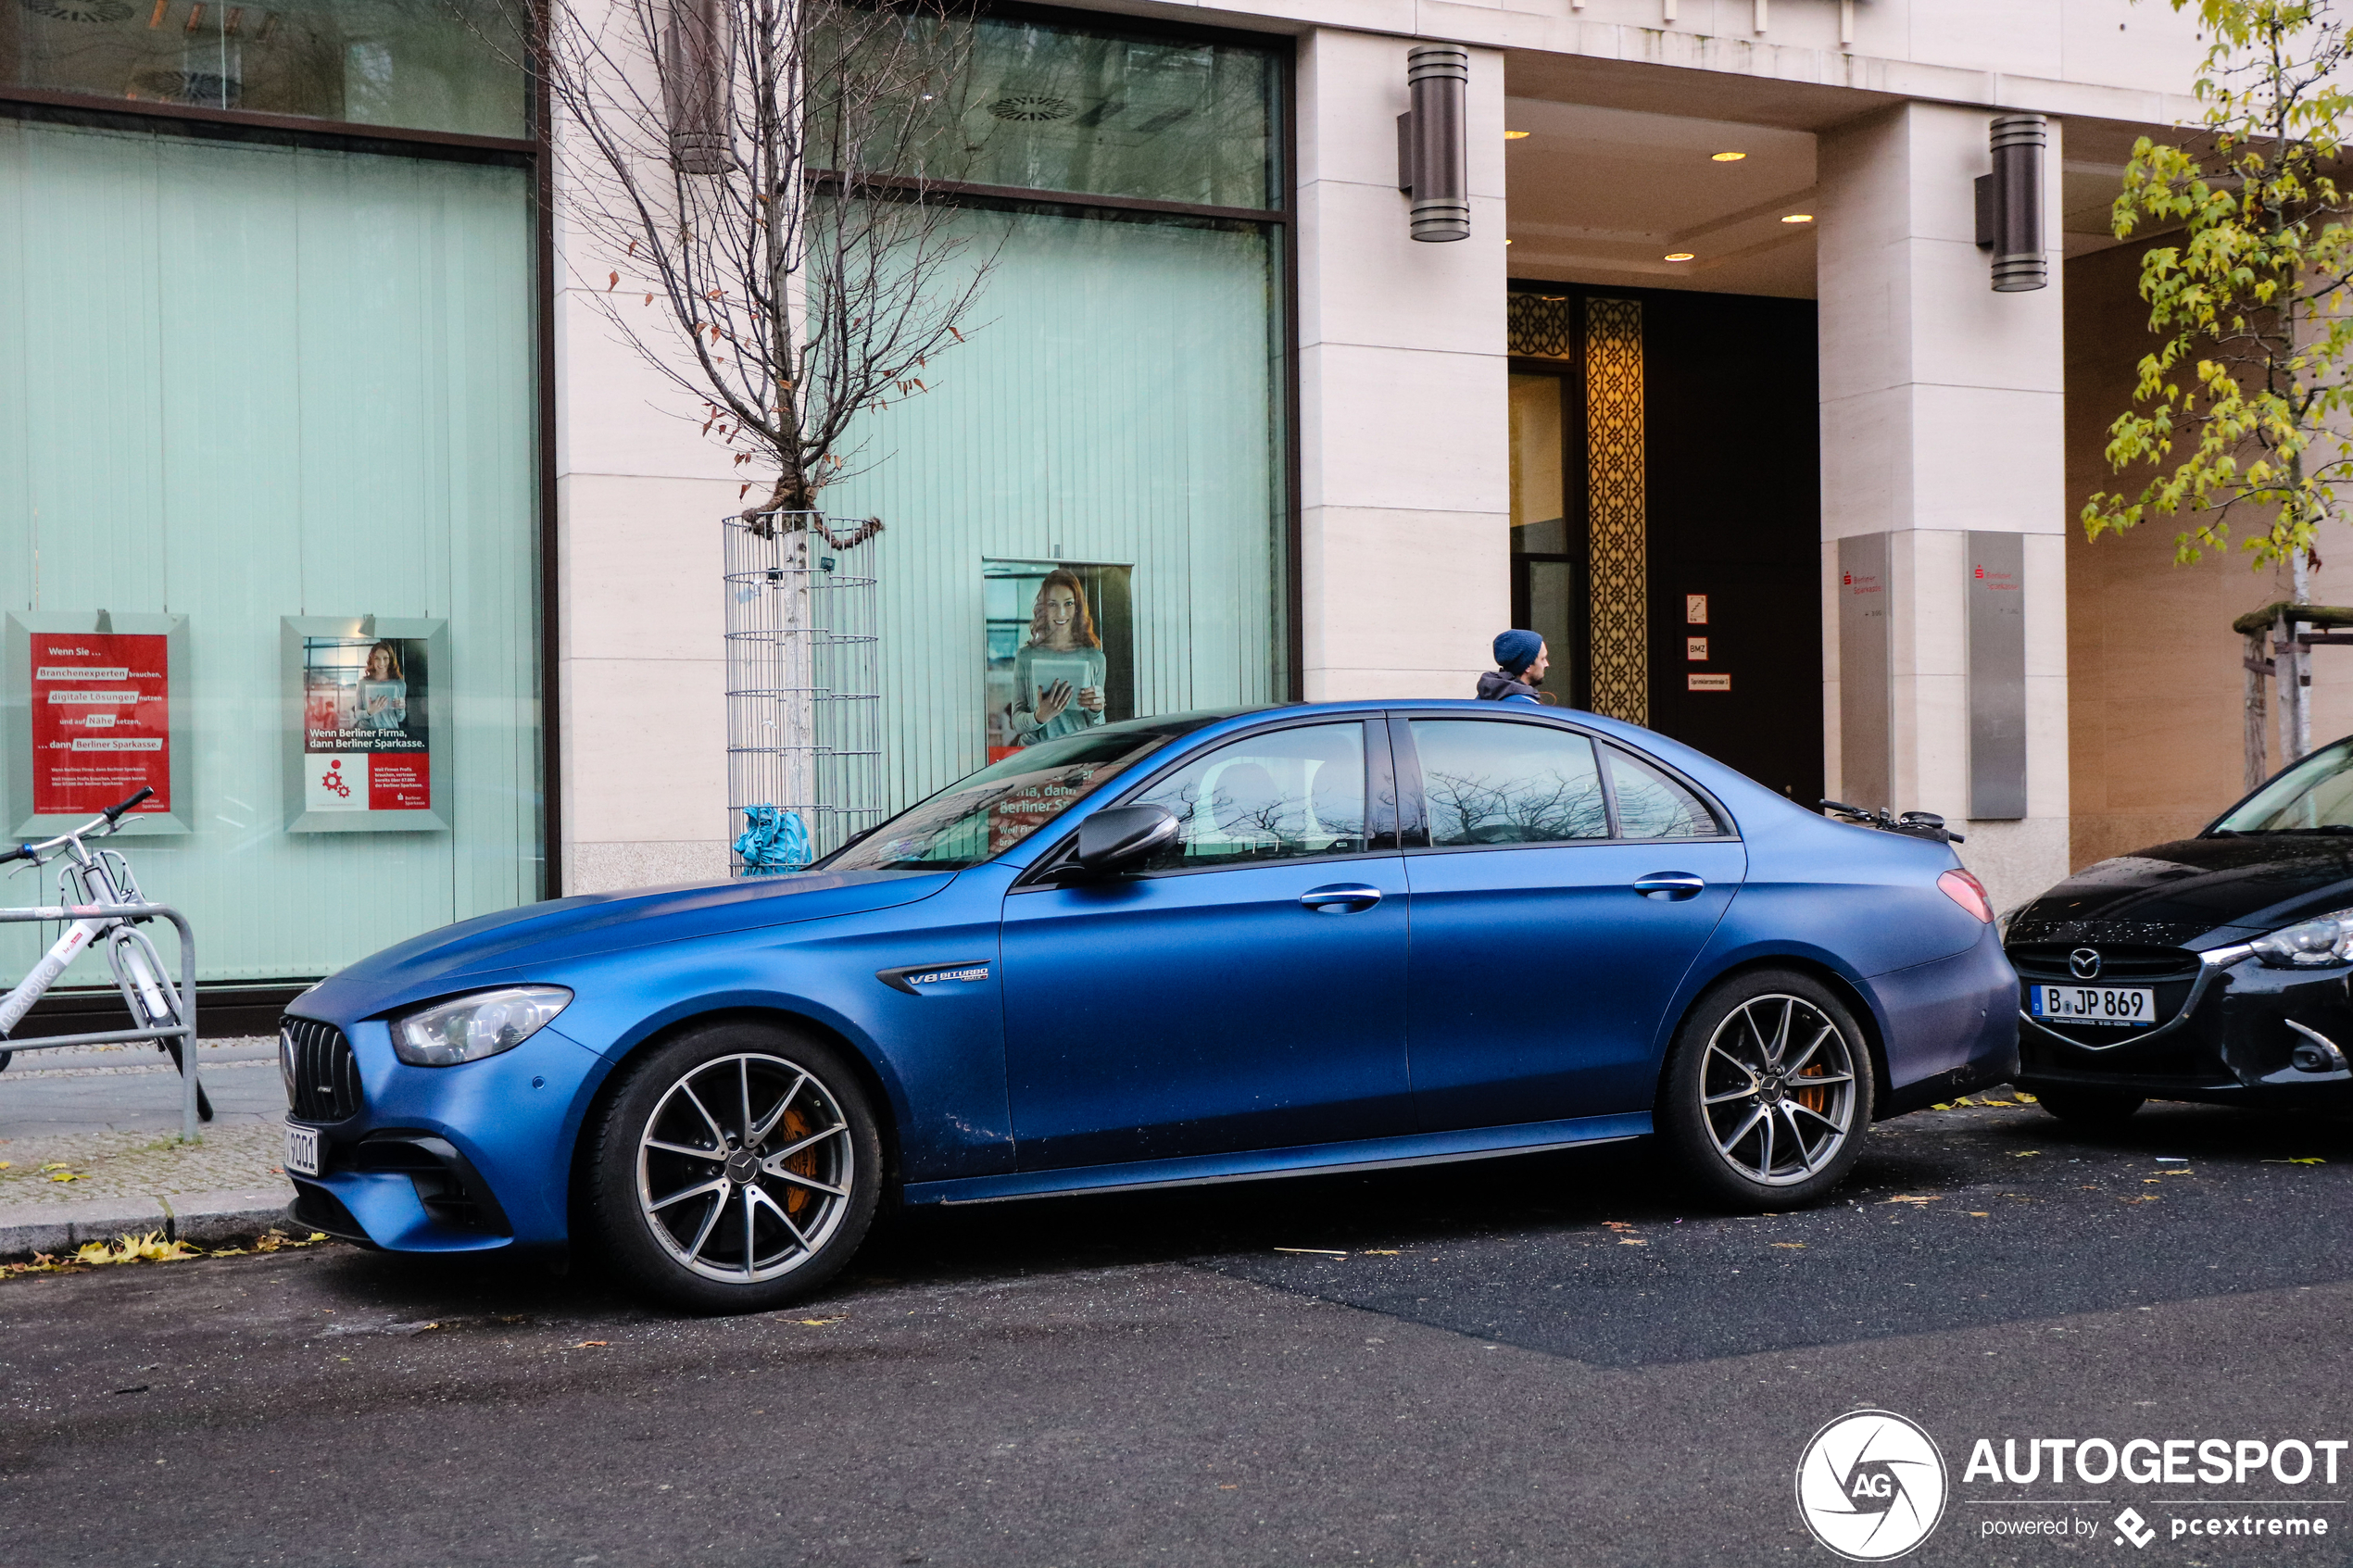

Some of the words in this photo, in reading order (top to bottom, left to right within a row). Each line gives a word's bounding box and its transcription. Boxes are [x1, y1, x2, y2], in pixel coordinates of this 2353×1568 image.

[48, 647, 74, 655] Wenn
[76, 647, 89, 655] Sie
[40, 669, 125, 678] Branchenexperten
[51, 693, 88, 702] digitale
[90, 693, 135, 702] Lösungen
[309, 728, 337, 737] Wenn
[339, 728, 377, 737] Berliner
[378, 728, 407, 738] Firma,
[49, 740, 72, 749] dann
[113, 741, 159, 750] Sparkasse.
[310, 739, 333, 748] dann
[336, 739, 372, 748] Berliner
[375, 739, 425, 749] Sparkasse.
[1000, 800, 1052, 814] Berliner
[999, 825, 1017, 834] Weil
[909, 973, 937, 985] V8
[940, 968, 988, 979] BITURBO
[0, 964, 58, 1028] nextbike
[2049, 989, 2061, 1013] B
[2075, 990, 2098, 1014] JP
[2104, 991, 2143, 1016] 869
[291, 1132, 315, 1169] 9001
